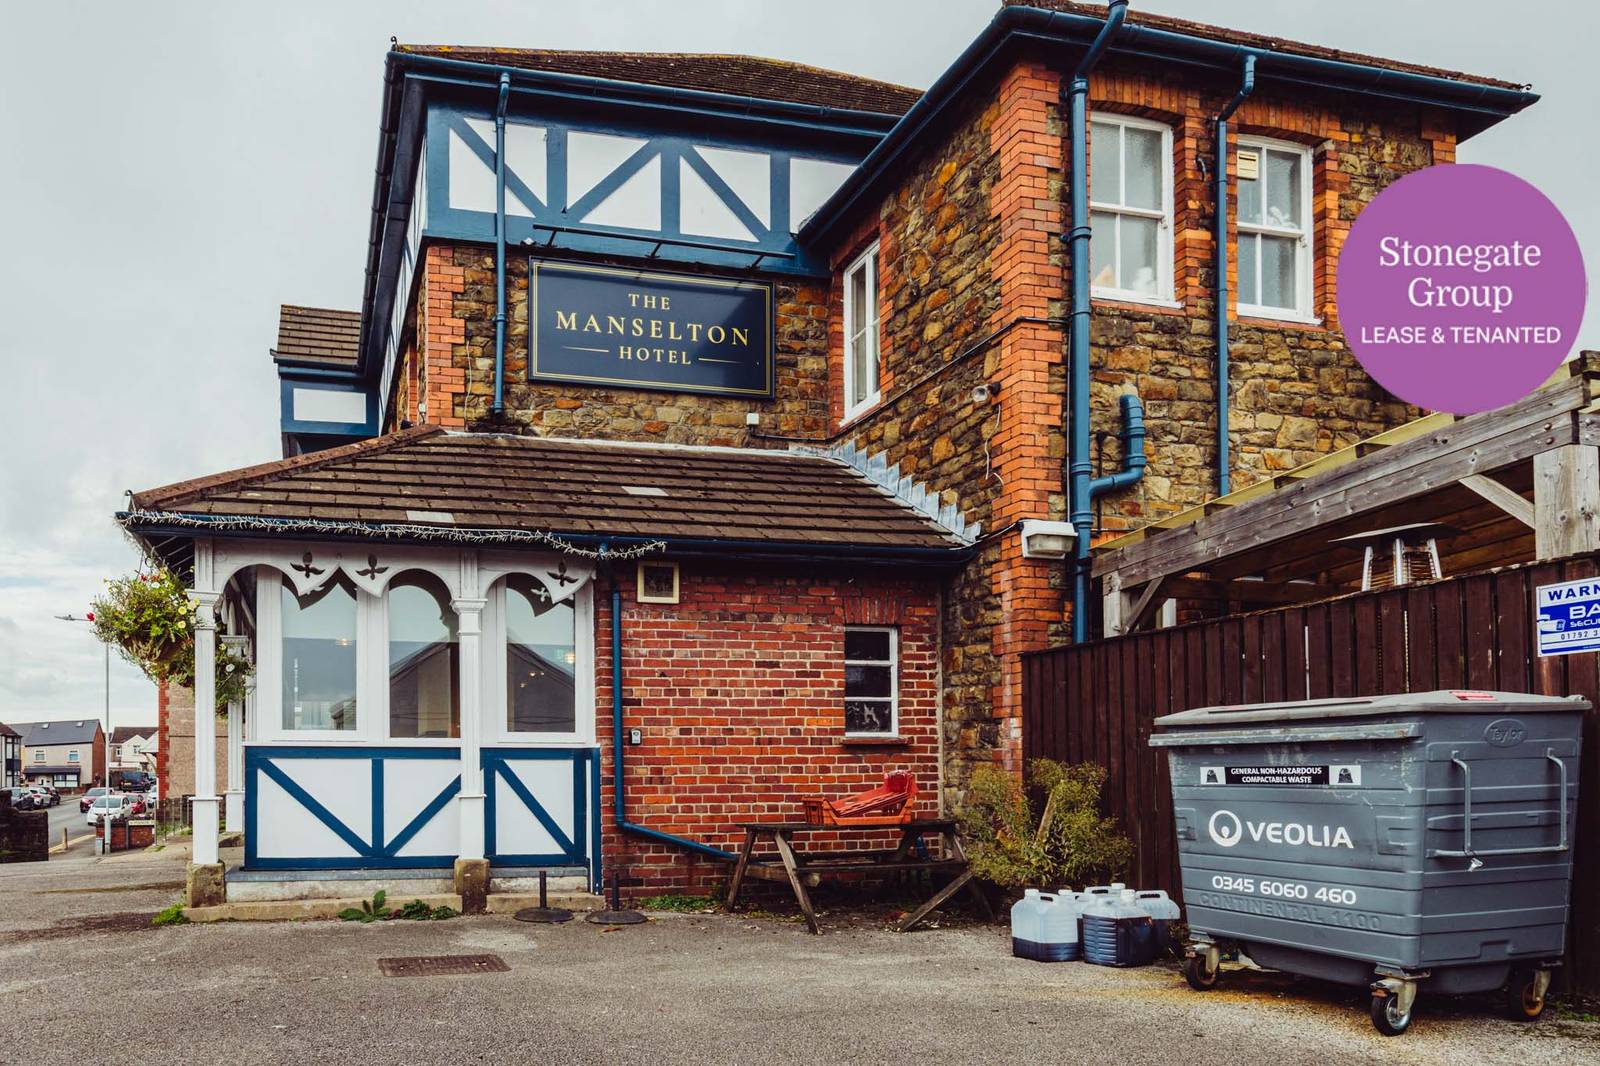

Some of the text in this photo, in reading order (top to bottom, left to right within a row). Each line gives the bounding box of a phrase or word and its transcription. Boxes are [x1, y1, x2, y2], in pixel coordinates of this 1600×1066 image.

[628, 293, 671, 310] THE
[555, 310, 750, 347] MANSELTON
[618, 346, 692, 366] HOTEL
[1569, 603, 1600, 619] BA
[1489, 726, 1523, 743] Taylor
[1231, 767, 1322, 775] GENERAL NON-HAZARDOUS
[1242, 775, 1287, 783] COMPACTABLE
[1246, 821, 1354, 849] VEOLIA
[1212, 875, 1357, 905] 0345 6060 460
[1200, 893, 1323, 921] CONTINENTAL
